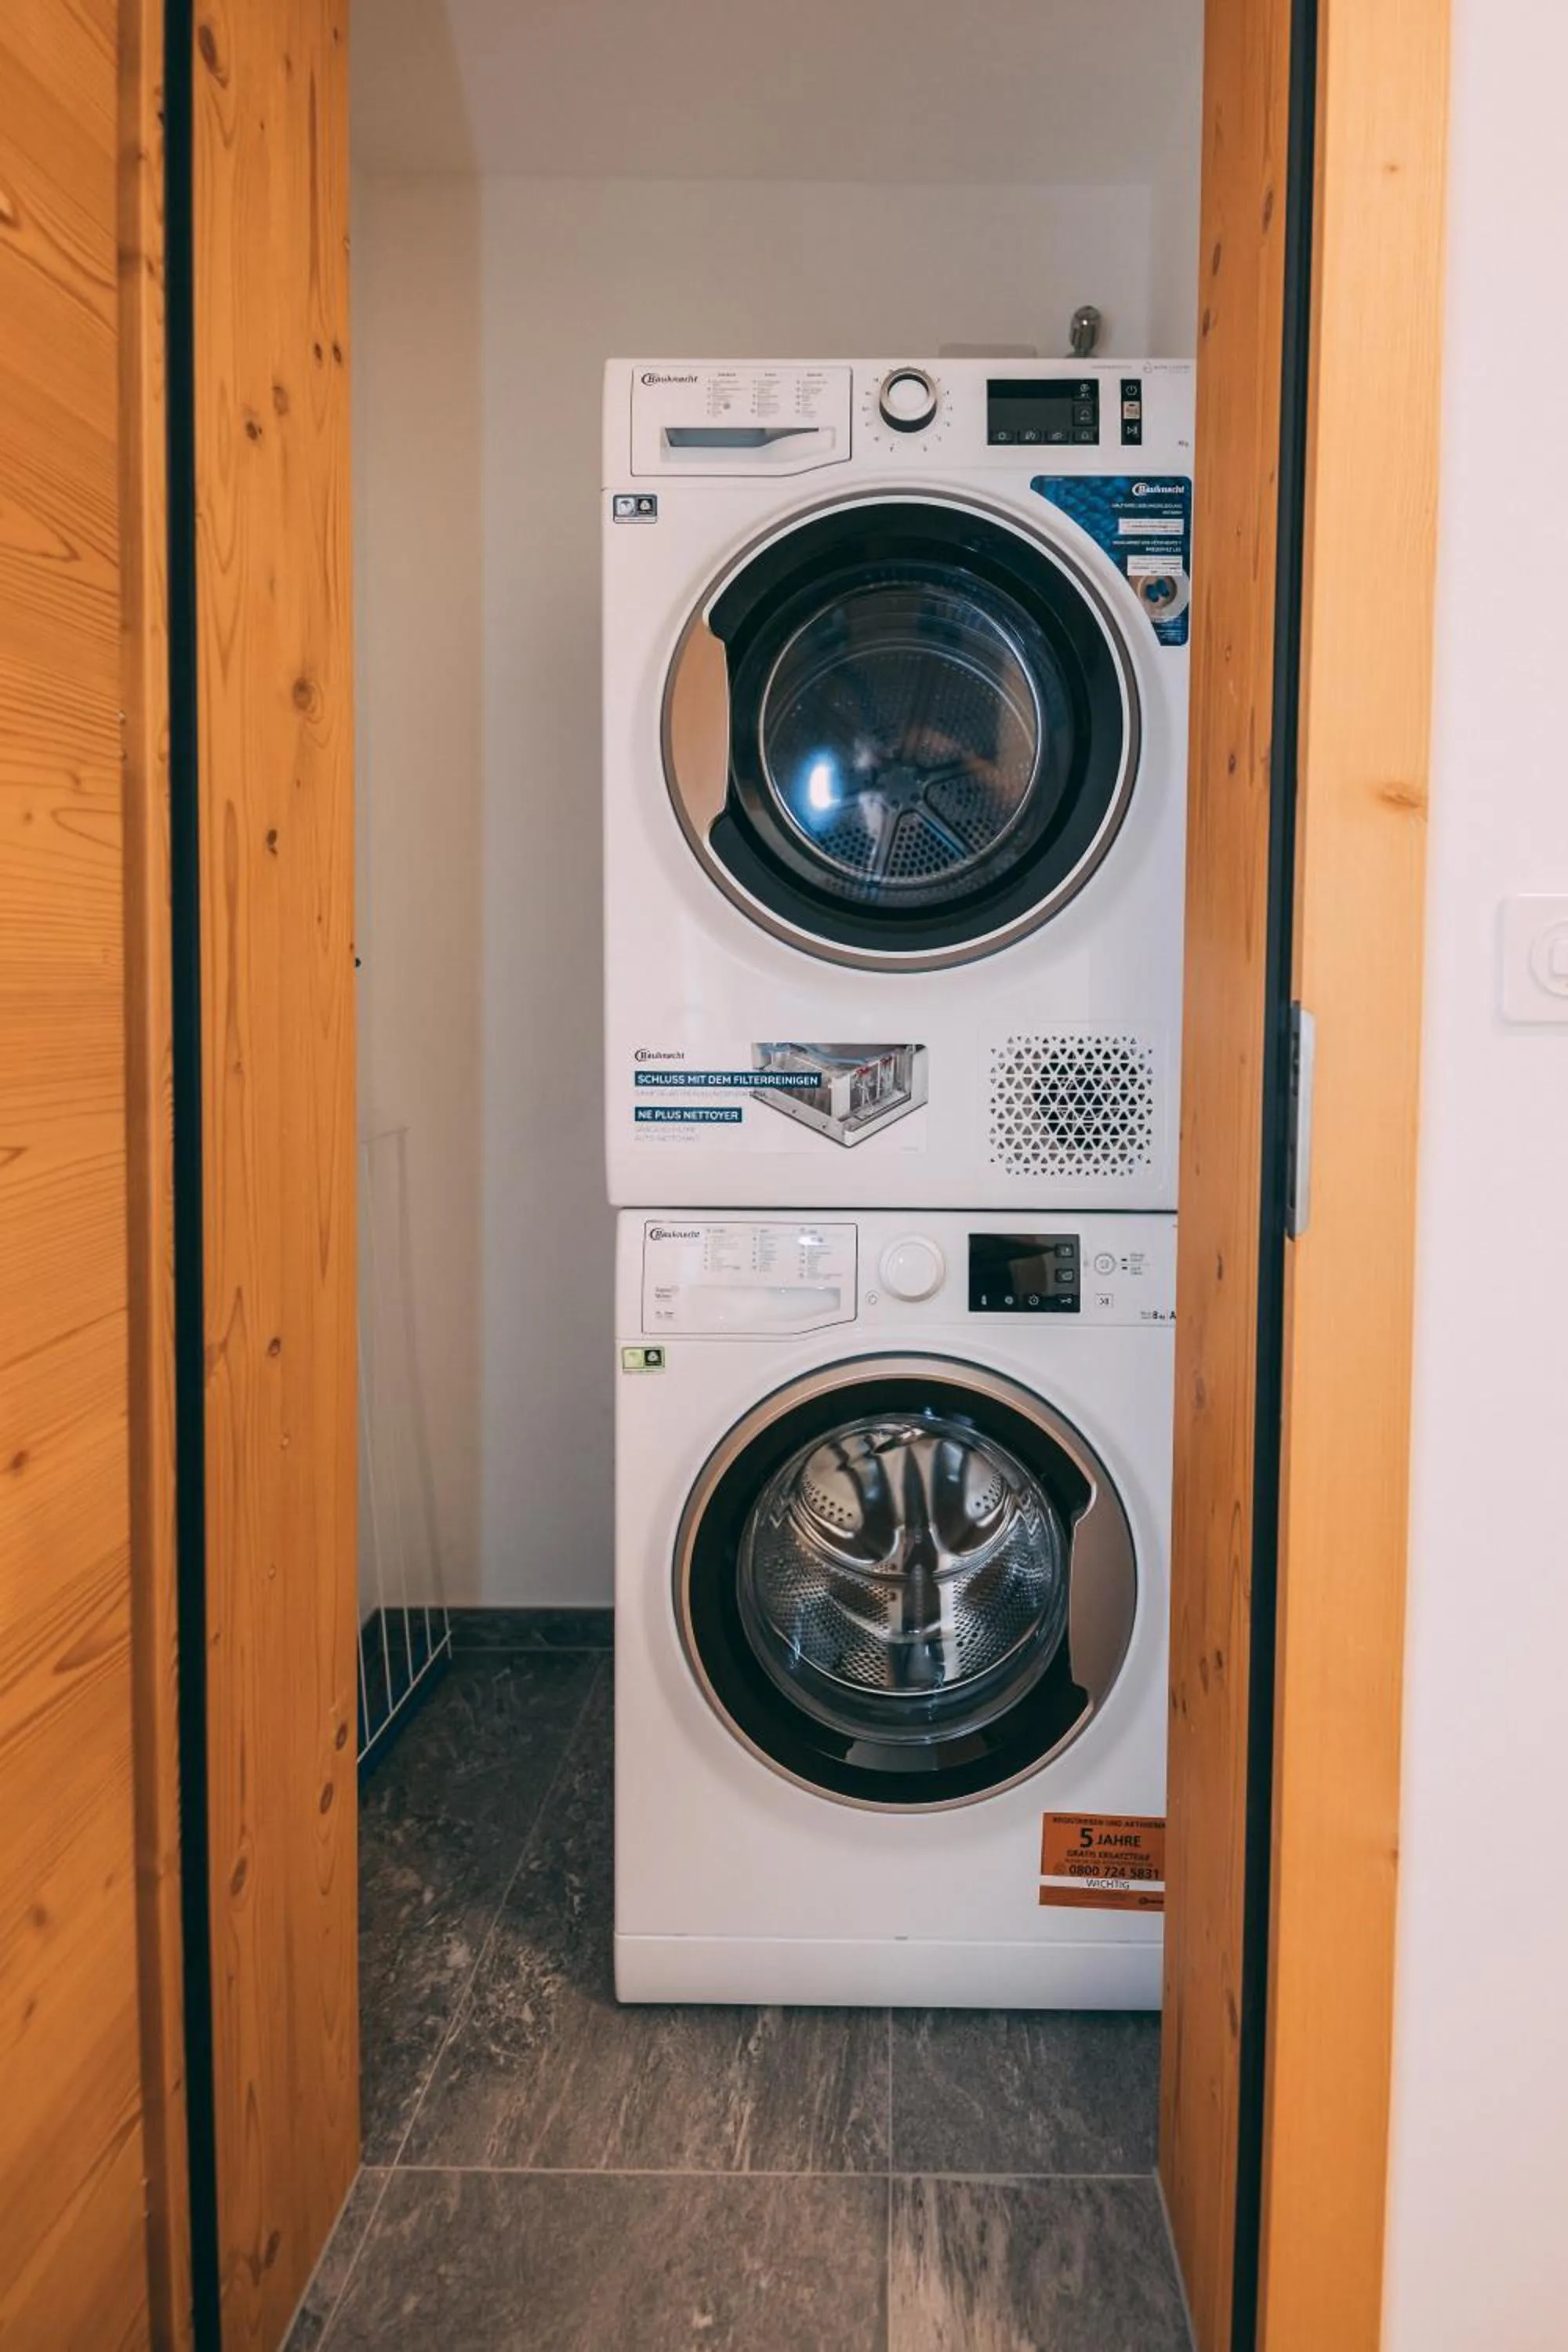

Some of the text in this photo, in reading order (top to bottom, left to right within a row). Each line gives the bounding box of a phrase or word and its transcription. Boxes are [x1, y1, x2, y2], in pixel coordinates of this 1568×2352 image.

[641, 372, 698, 386] Bauknecht
[1132, 483, 1185, 495] Bauknecht
[637, 1075, 818, 1087] SCHLUSS MIT DEM FILTERREINIGEN
[637, 1110, 739, 1122] NE PLUS NETTOYER
[1080, 1828, 1142, 1848] 5 JAHRE
[1066, 1849, 1097, 1859] GRATIS
[1069, 1864, 1160, 1880] 0800 724 5831
[1086, 1878, 1130, 1889] WICHTIG
